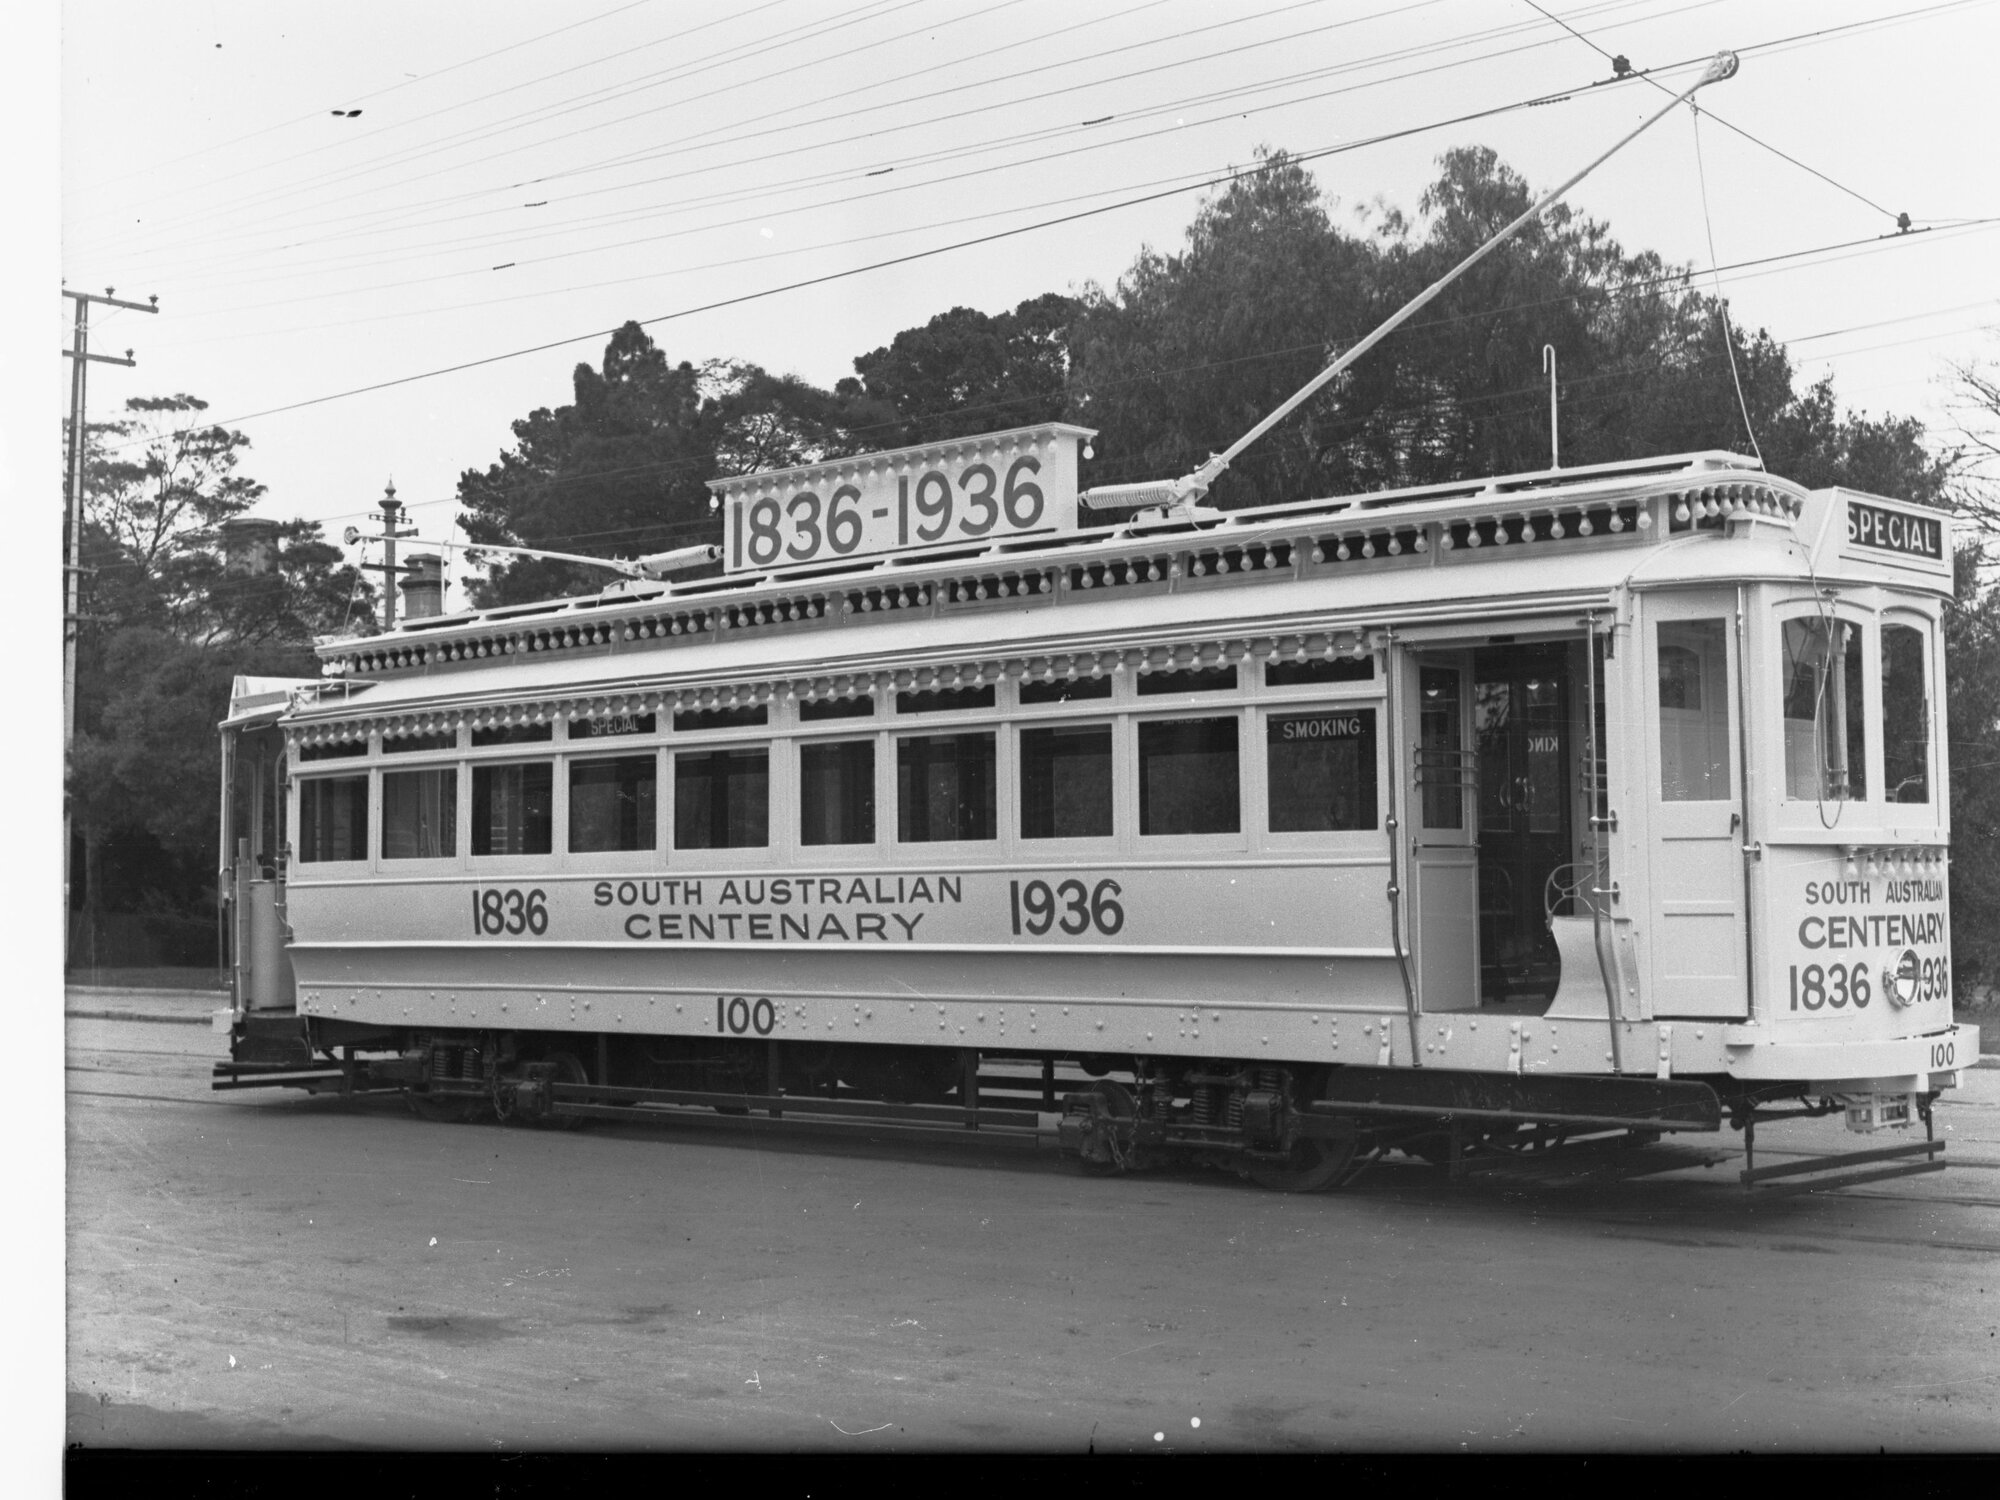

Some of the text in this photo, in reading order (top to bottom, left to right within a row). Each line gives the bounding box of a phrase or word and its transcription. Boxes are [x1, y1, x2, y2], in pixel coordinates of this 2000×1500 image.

[1848, 507, 1936, 553] SPECIAL
[591, 715, 639, 735] SPECIAL
[1283, 717, 1361, 739] SMOKING
[594, 876, 962, 906] SOUTH AUSTRALIAN
[1010, 878, 1125, 936] 1936
[1805, 879, 1943, 905] SOUTH AUSTRALIAN
[473, 889, 548, 935] 1836
[624, 912, 925, 940] CENTENARY
[1798, 912, 1945, 949] CENTENARY
[1789, 962, 1871, 1011] 1836
[717, 997, 775, 1035] 100
[1931, 1041, 1955, 1068] 100
